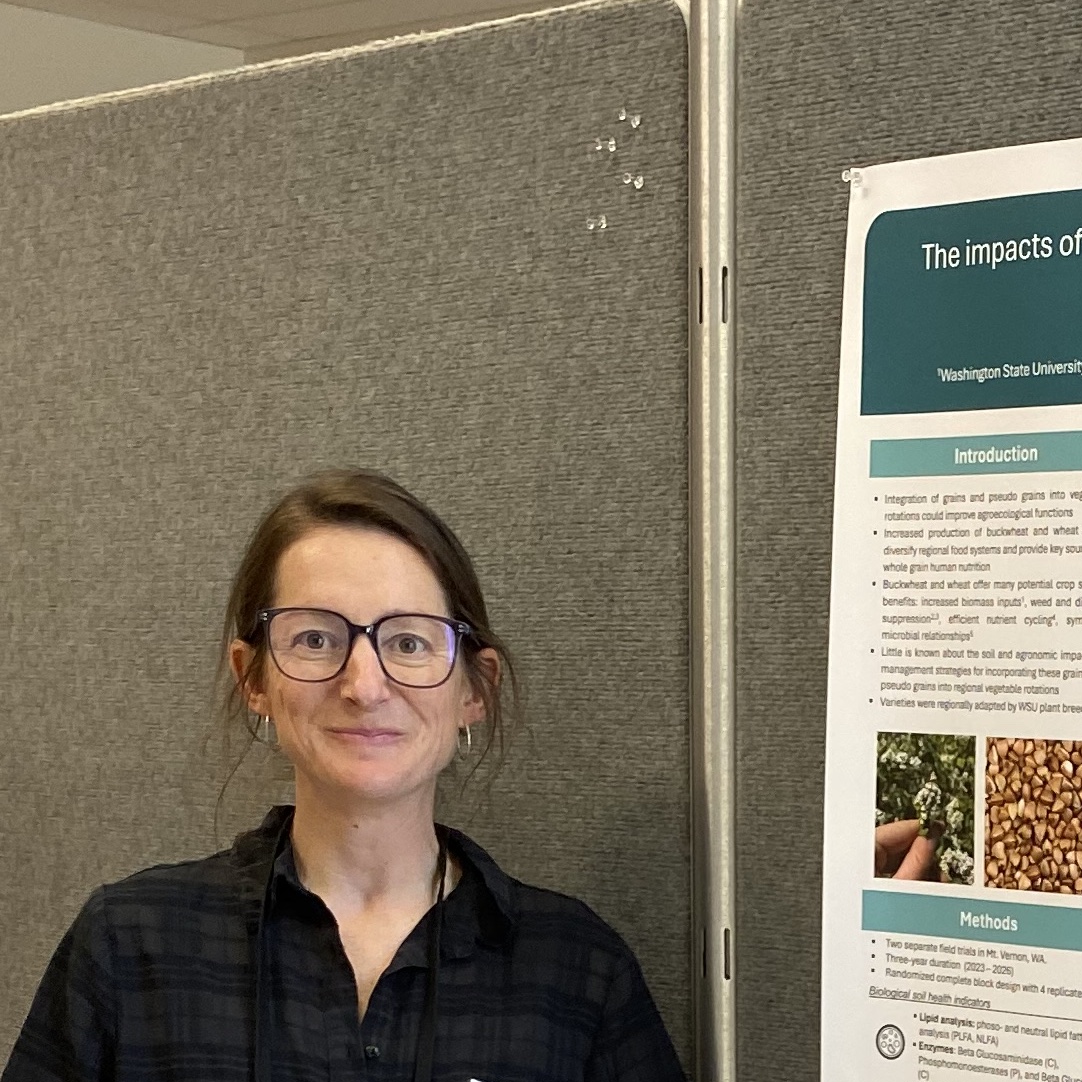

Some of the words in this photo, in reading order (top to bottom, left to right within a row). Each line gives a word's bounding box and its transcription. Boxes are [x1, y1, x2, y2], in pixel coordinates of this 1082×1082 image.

[921, 242, 960, 270] The
[965, 233, 1053, 270] impacts
[1002, 363, 1030, 378] State
[954, 445, 1038, 464] Introduction
[960, 911, 1018, 931] Methods
